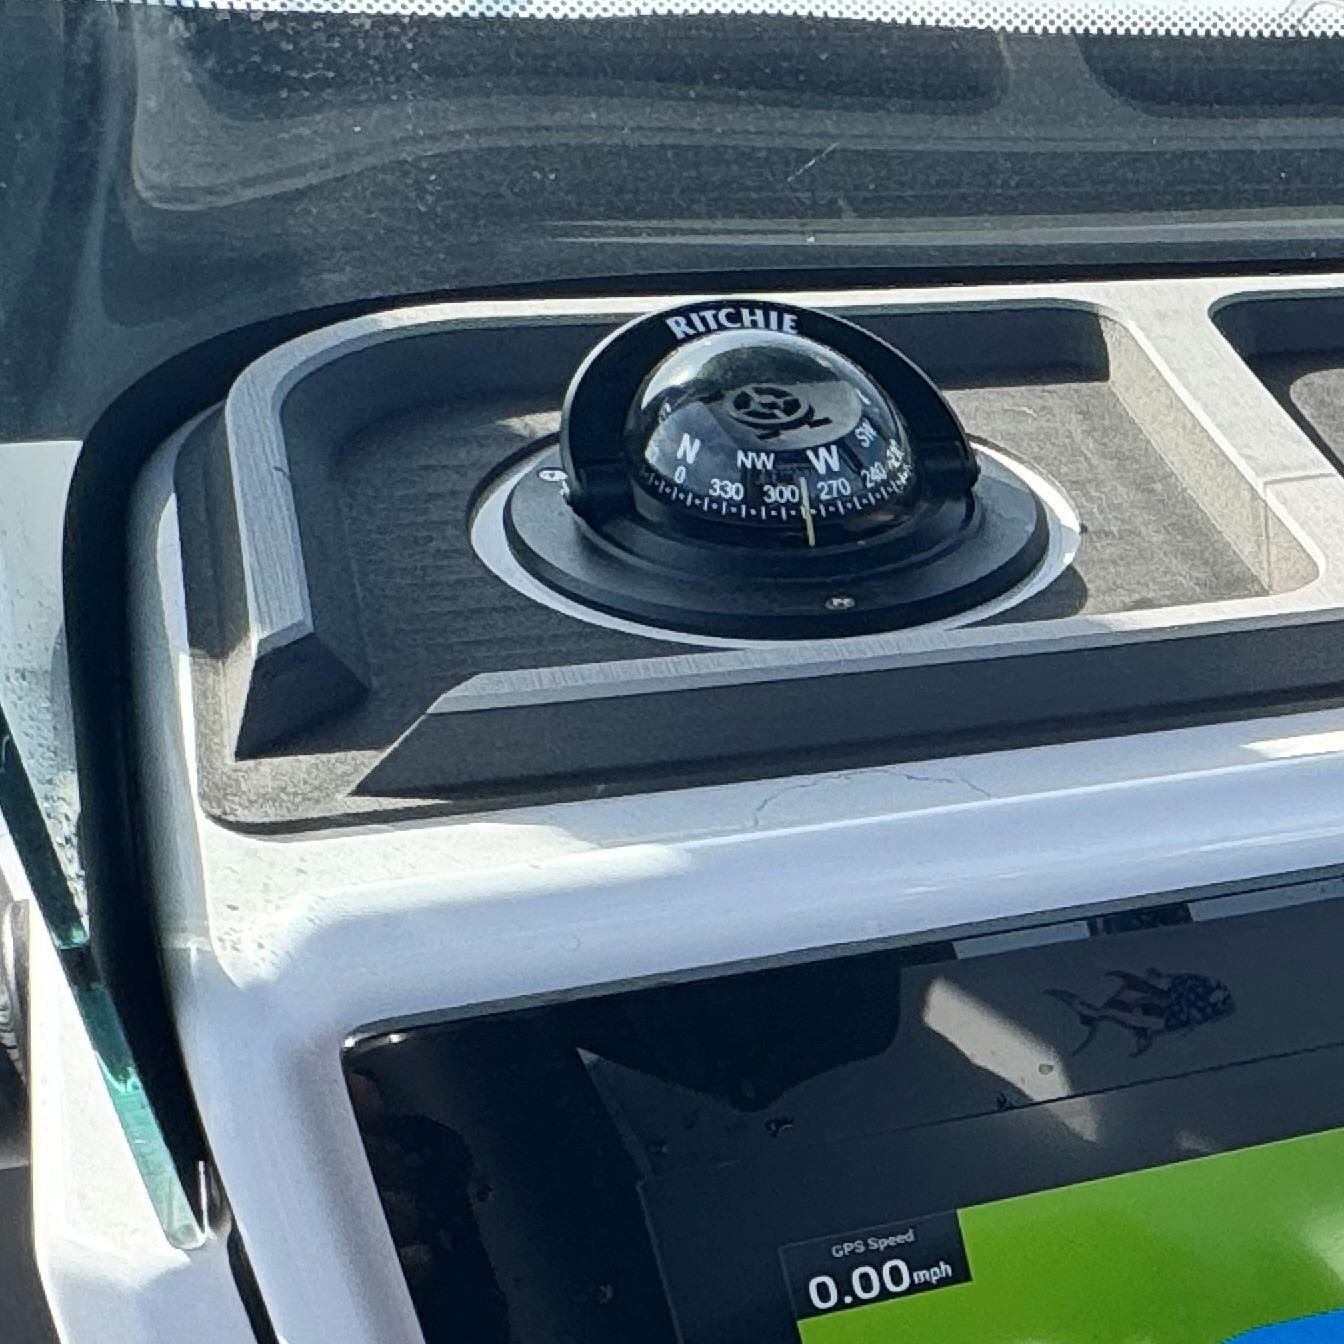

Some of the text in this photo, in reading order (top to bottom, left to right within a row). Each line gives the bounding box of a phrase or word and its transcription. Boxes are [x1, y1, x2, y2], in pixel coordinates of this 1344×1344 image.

[665, 307, 799, 341] RITCHIE
[676, 432, 700, 464] N
[736, 450, 775, 471] NW
[806, 445, 841, 475] W
[674, 466, 687, 484] 0
[708, 478, 744, 501] 330
[763, 484, 800, 504] 300
[816, 477, 851, 501] 270
[831, 1228, 916, 1258] GPS Speed
